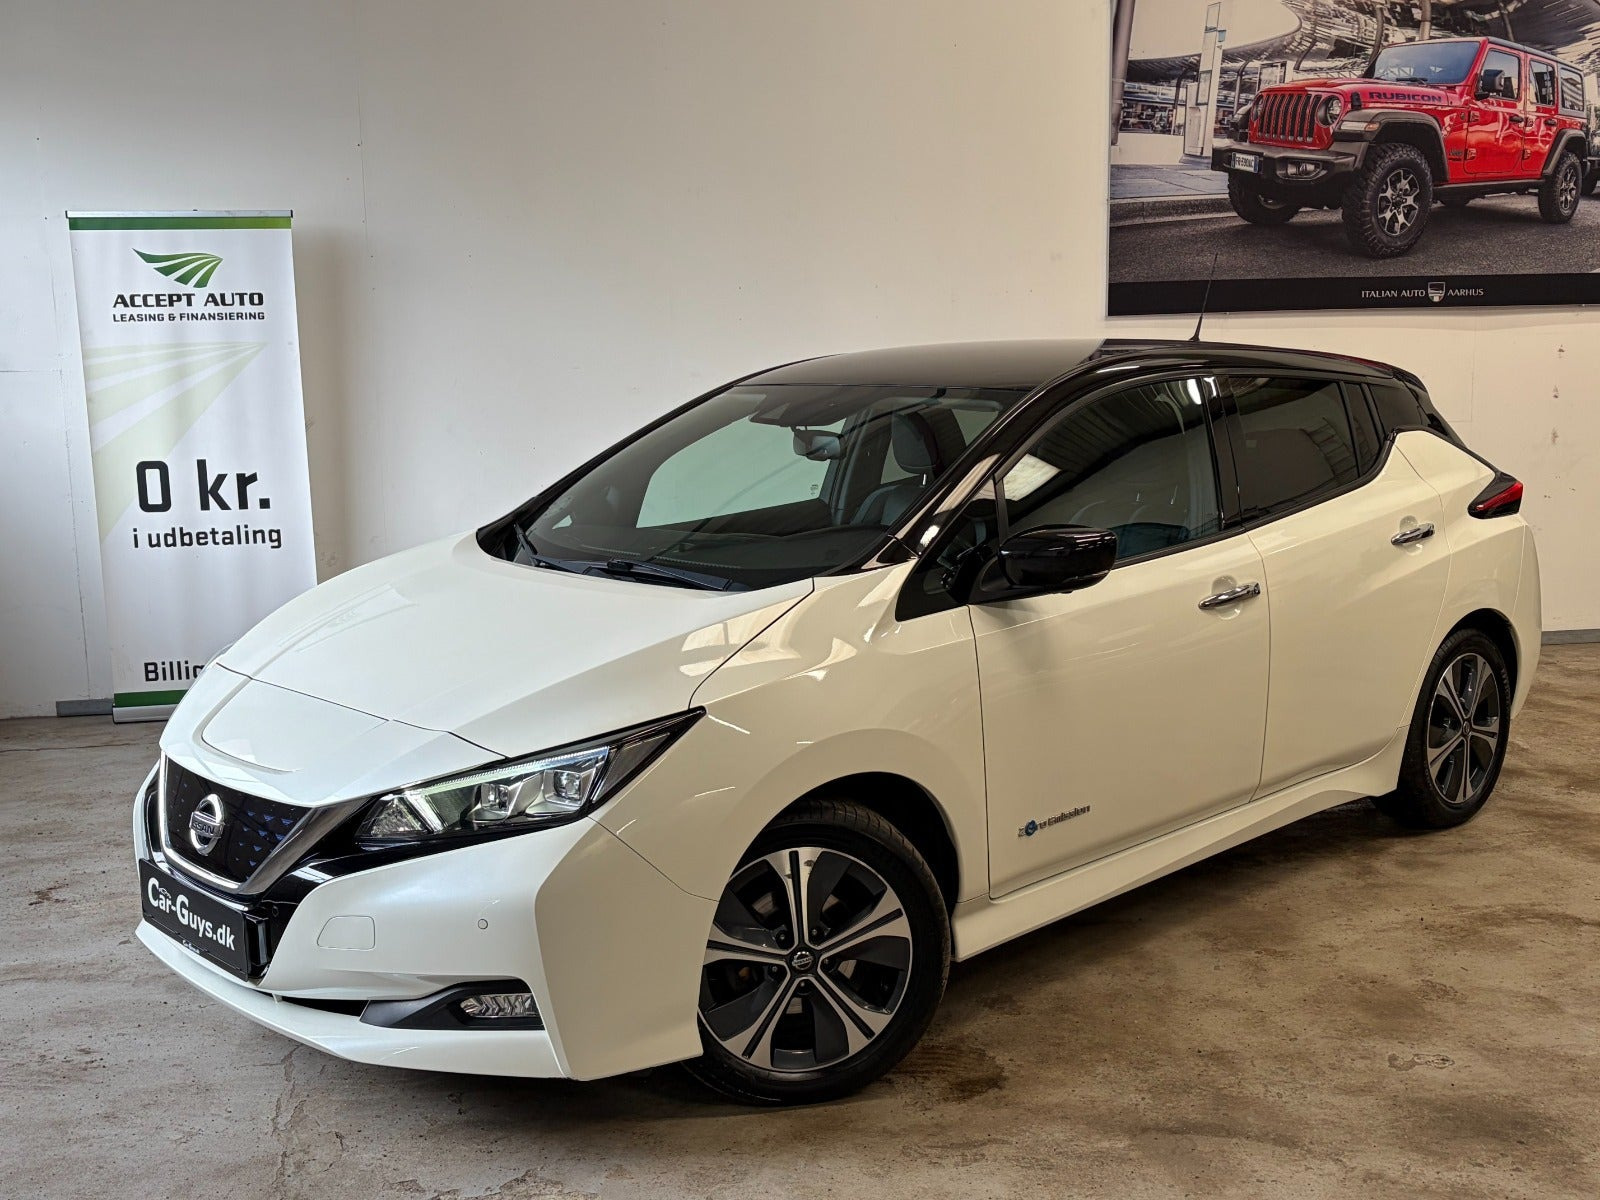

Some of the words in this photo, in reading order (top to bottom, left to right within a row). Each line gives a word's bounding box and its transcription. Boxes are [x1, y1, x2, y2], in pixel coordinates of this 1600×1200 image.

[1368, 91, 1442, 102] RUBICON
[112, 293, 196, 309] ACCEPT
[203, 292, 264, 307] AUTO
[1361, 290, 1398, 298] ITALIAN
[1400, 289, 1426, 297] AUTO
[1447, 288, 1484, 296] AARHUS
[112, 313, 165, 323] LEASING
[168, 313, 177, 322] &
[179, 311, 265, 321] FINANSIERING
[196, 458, 271, 511] kr.
[132, 527, 139, 549] i
[147, 524, 282, 549] udbetaling
[147, 877, 236, 951] Car-Guys.dk
